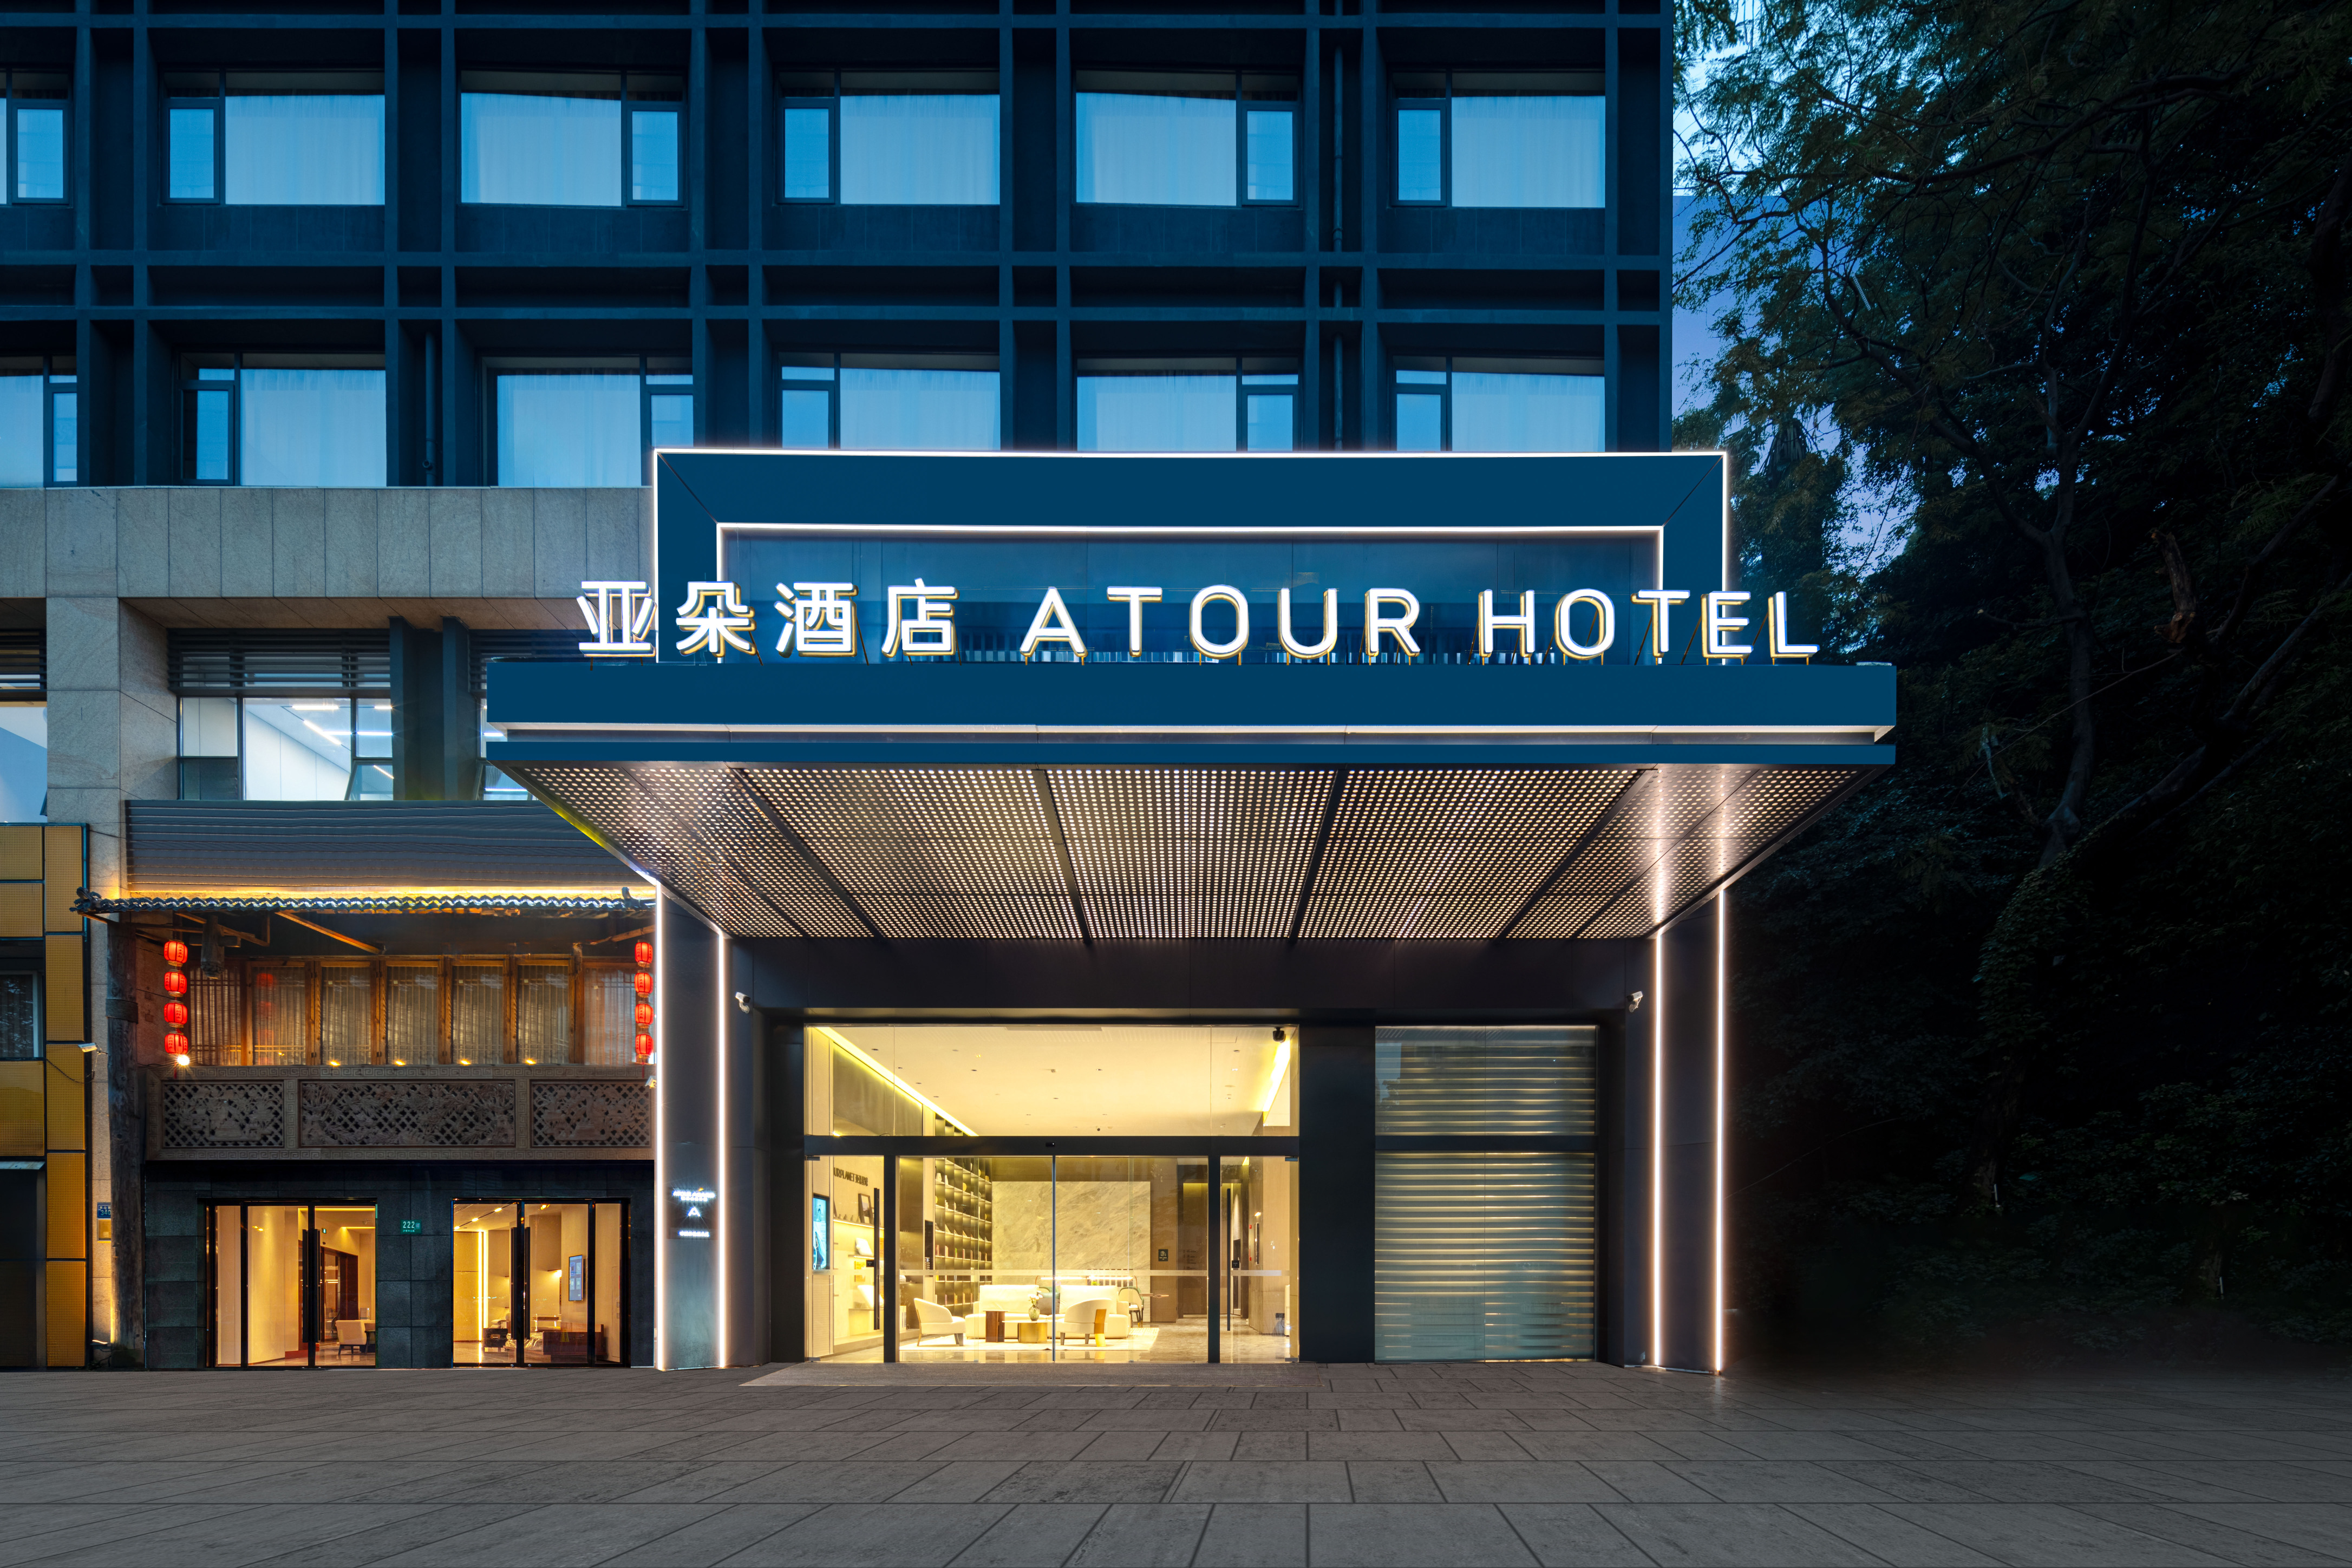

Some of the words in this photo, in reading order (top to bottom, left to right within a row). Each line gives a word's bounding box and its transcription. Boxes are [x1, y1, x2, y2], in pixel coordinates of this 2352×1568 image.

[576, 578, 959, 658] 亚朵酒店
[1020, 585, 1421, 659] ATOUR
[1478, 588, 1820, 660] HOTEL
